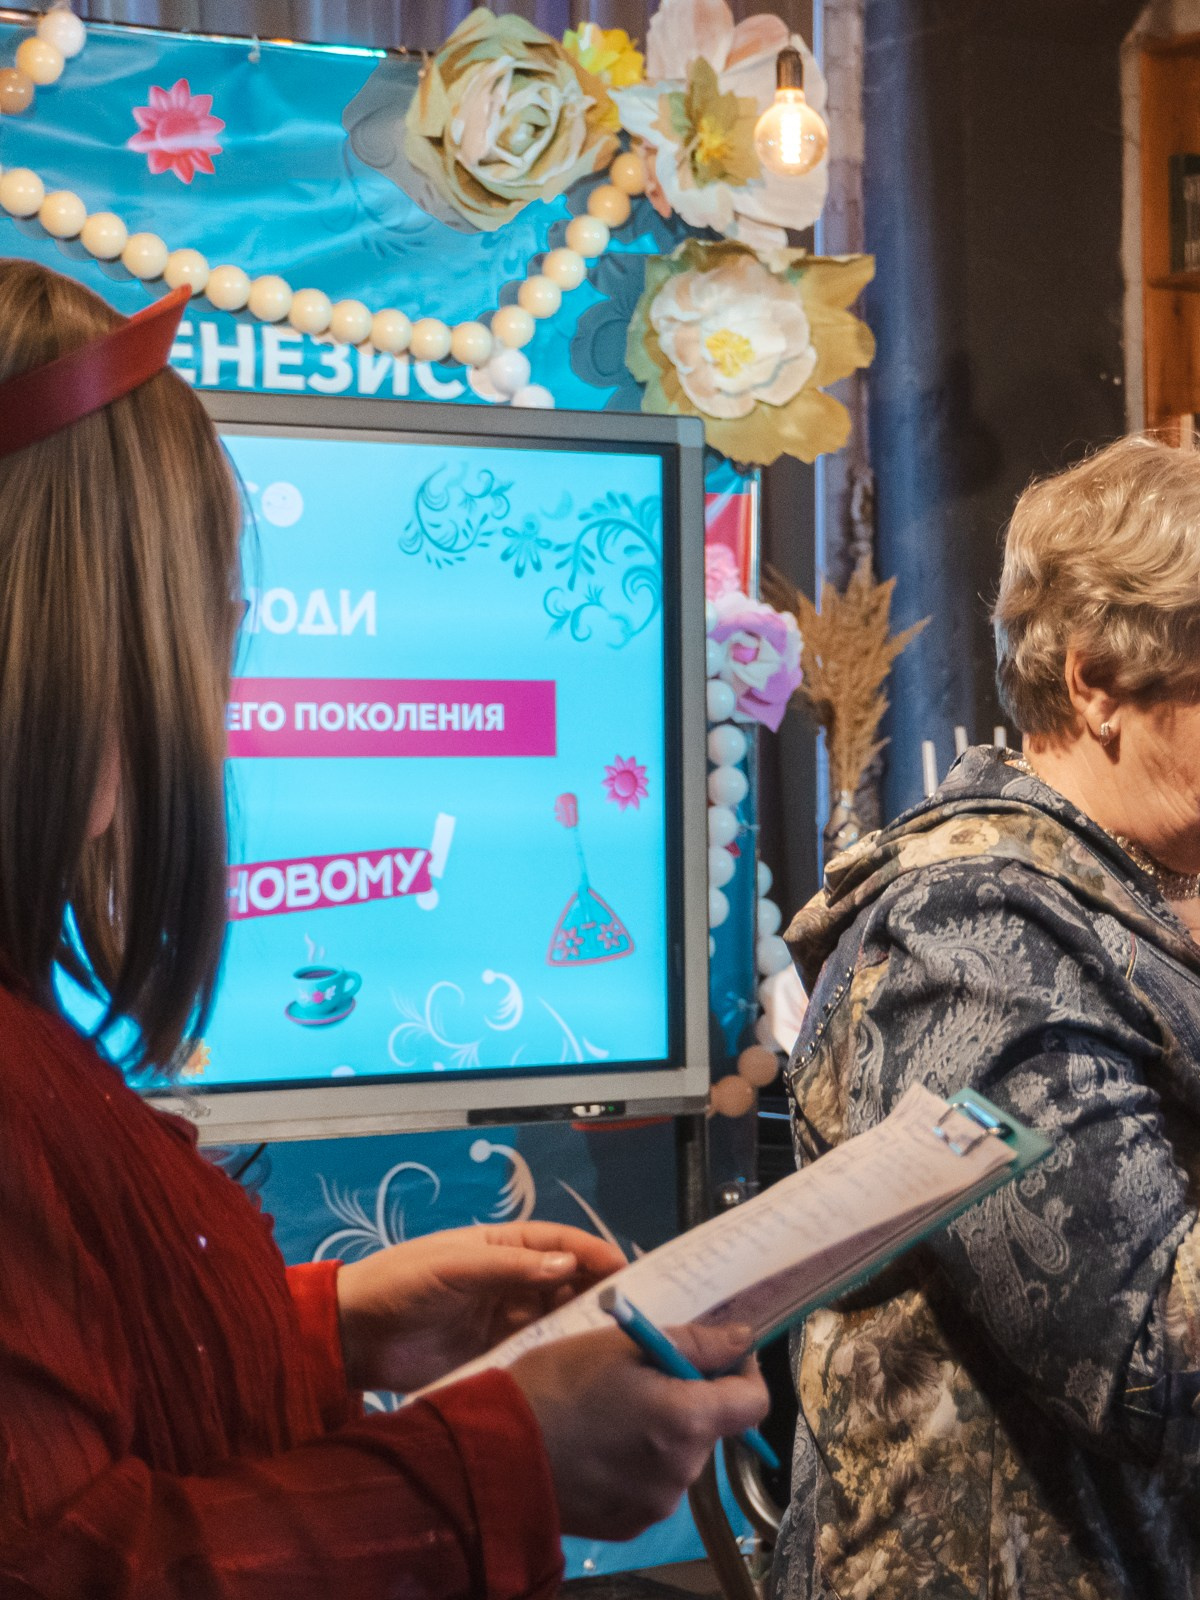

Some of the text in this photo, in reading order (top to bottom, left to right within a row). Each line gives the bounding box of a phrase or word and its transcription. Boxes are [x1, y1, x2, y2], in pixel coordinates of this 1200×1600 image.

[246, 587, 377, 636] ЮДИ
[227, 701, 505, 731] ЕГО ПОКОЛЕНИЯ
